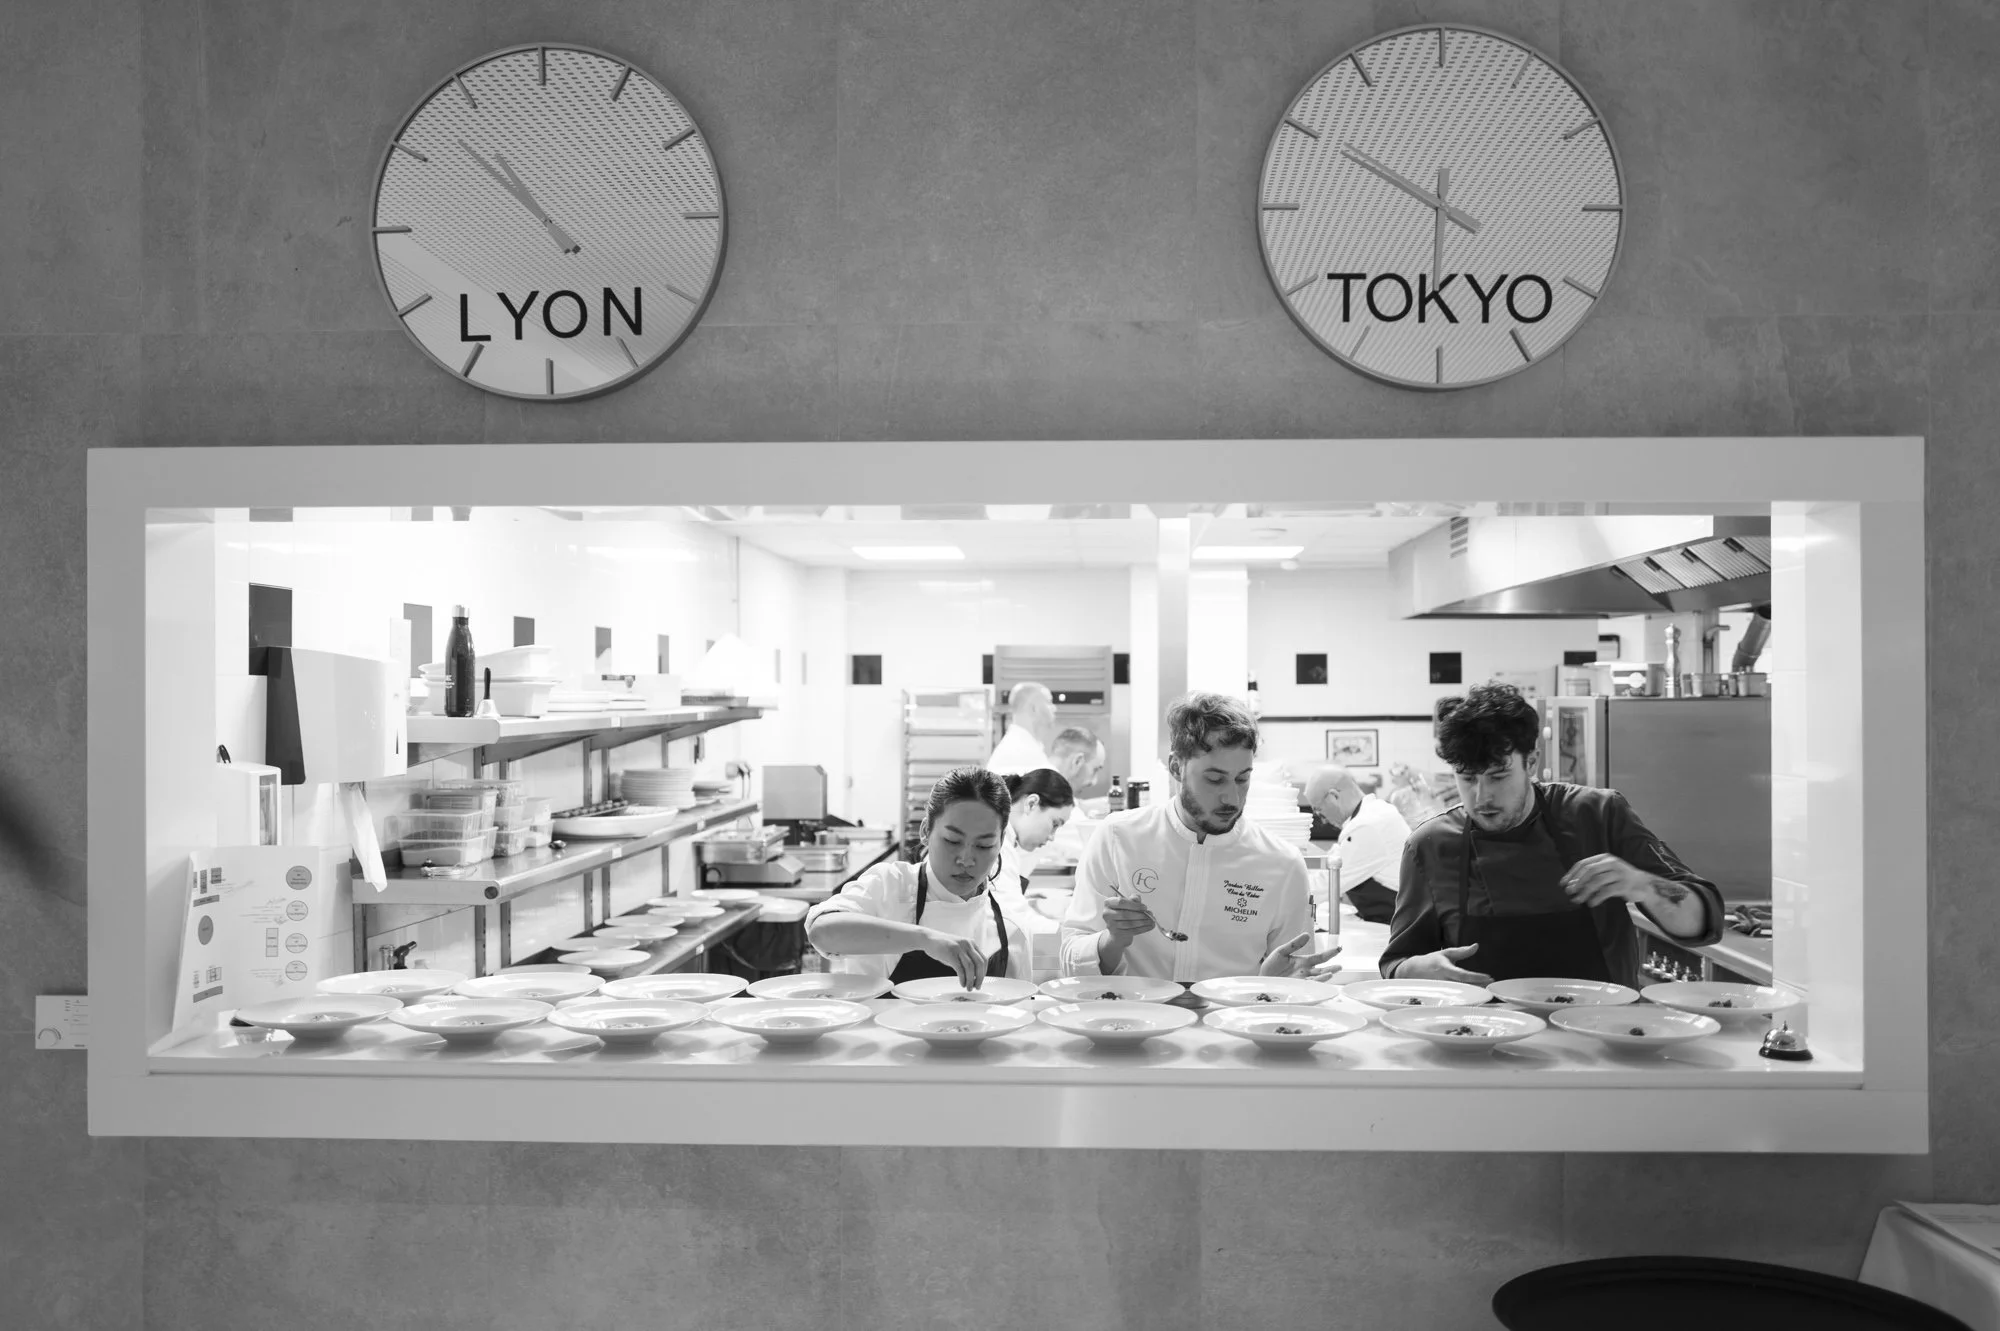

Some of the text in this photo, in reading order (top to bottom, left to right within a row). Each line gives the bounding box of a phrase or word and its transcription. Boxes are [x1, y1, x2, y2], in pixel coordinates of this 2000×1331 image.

[1327, 272, 1553, 324] TOKYO
[460, 287, 642, 342] LYON
[1224, 906, 1258, 916] MICHELIN
[1231, 915, 1248, 923] 2022
